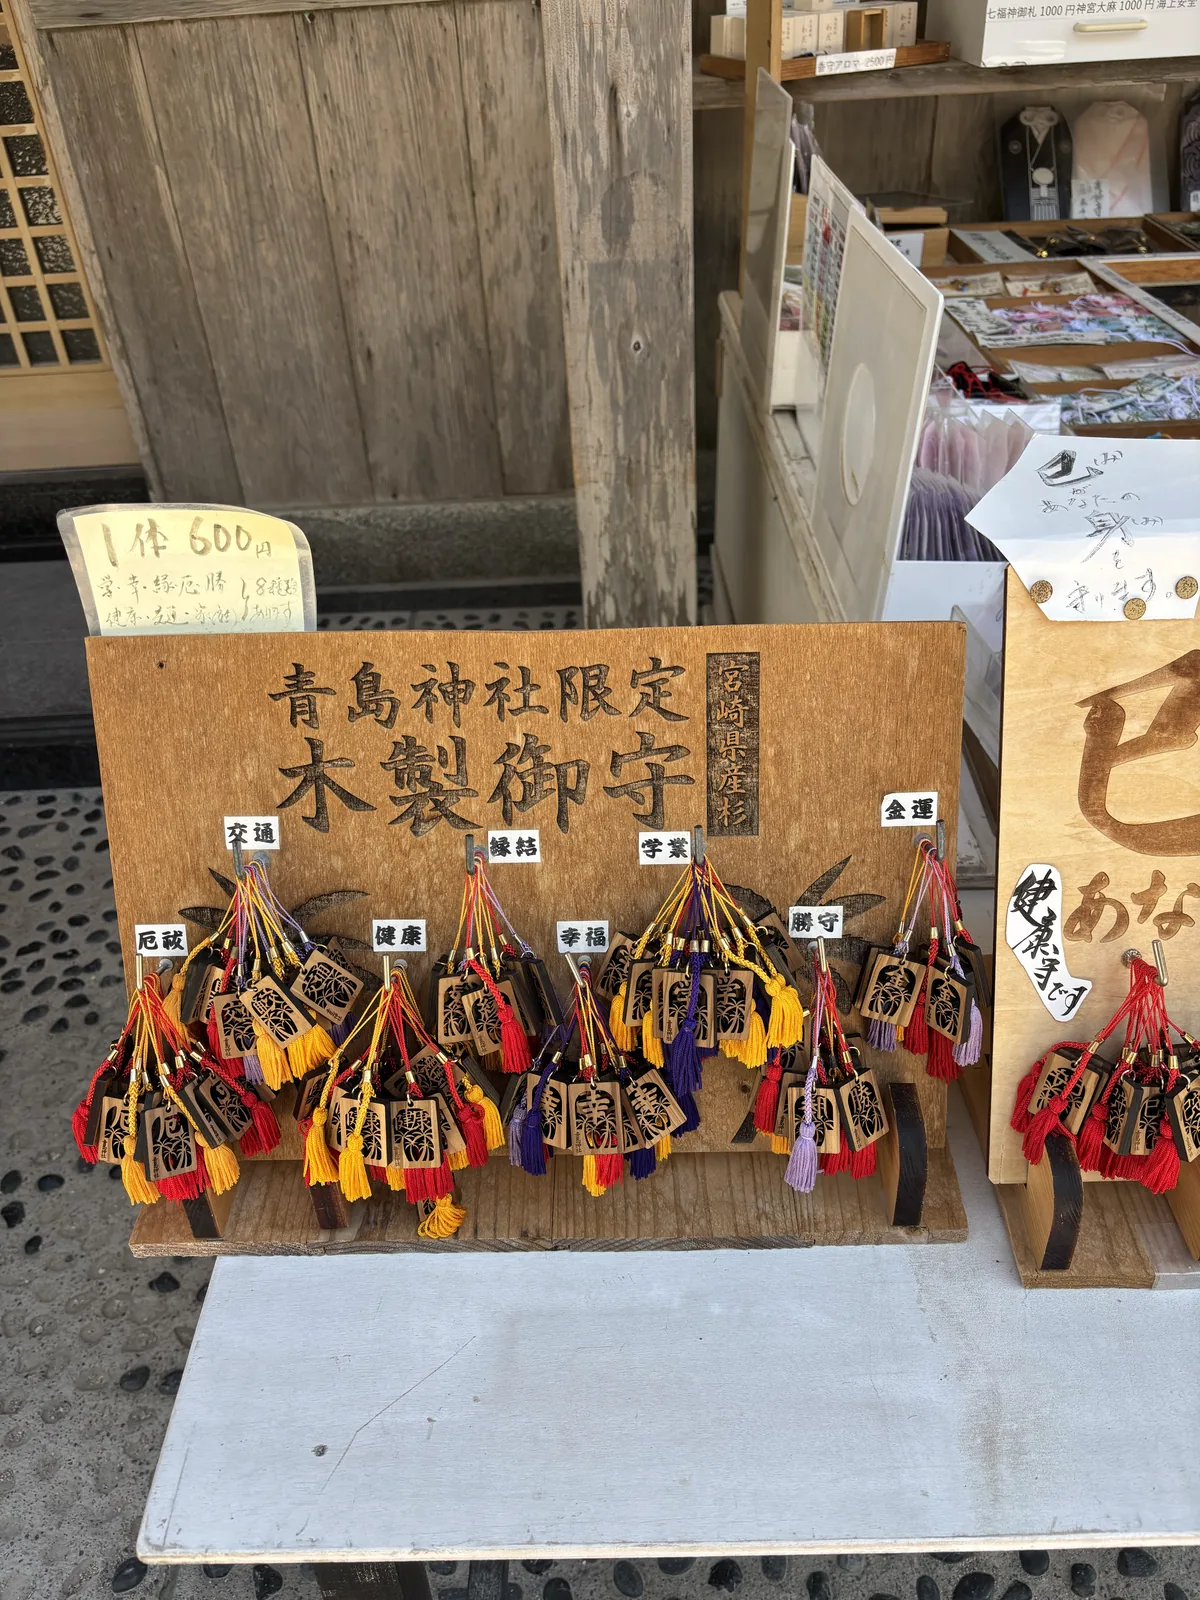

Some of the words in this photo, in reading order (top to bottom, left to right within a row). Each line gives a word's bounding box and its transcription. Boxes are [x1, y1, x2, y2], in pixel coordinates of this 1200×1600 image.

[1040, 5, 1063, 17] 1000
[1120, 0, 1143, 11] 1000
[268, 656, 691, 730] 青島神社限定
[715, 660, 751, 828] 宮崎県産杉
[276, 731, 696, 837] 木製御守
[884, 797, 934, 821] 金運
[226, 822, 277, 845] 交通
[489, 836, 538, 857] 縁結
[641, 836, 690, 859] 学業
[790, 911, 840, 933] 勝守
[138, 930, 187, 951] 厄祓
[374, 925, 422, 946] 健康
[559, 926, 607, 947] 幸福
